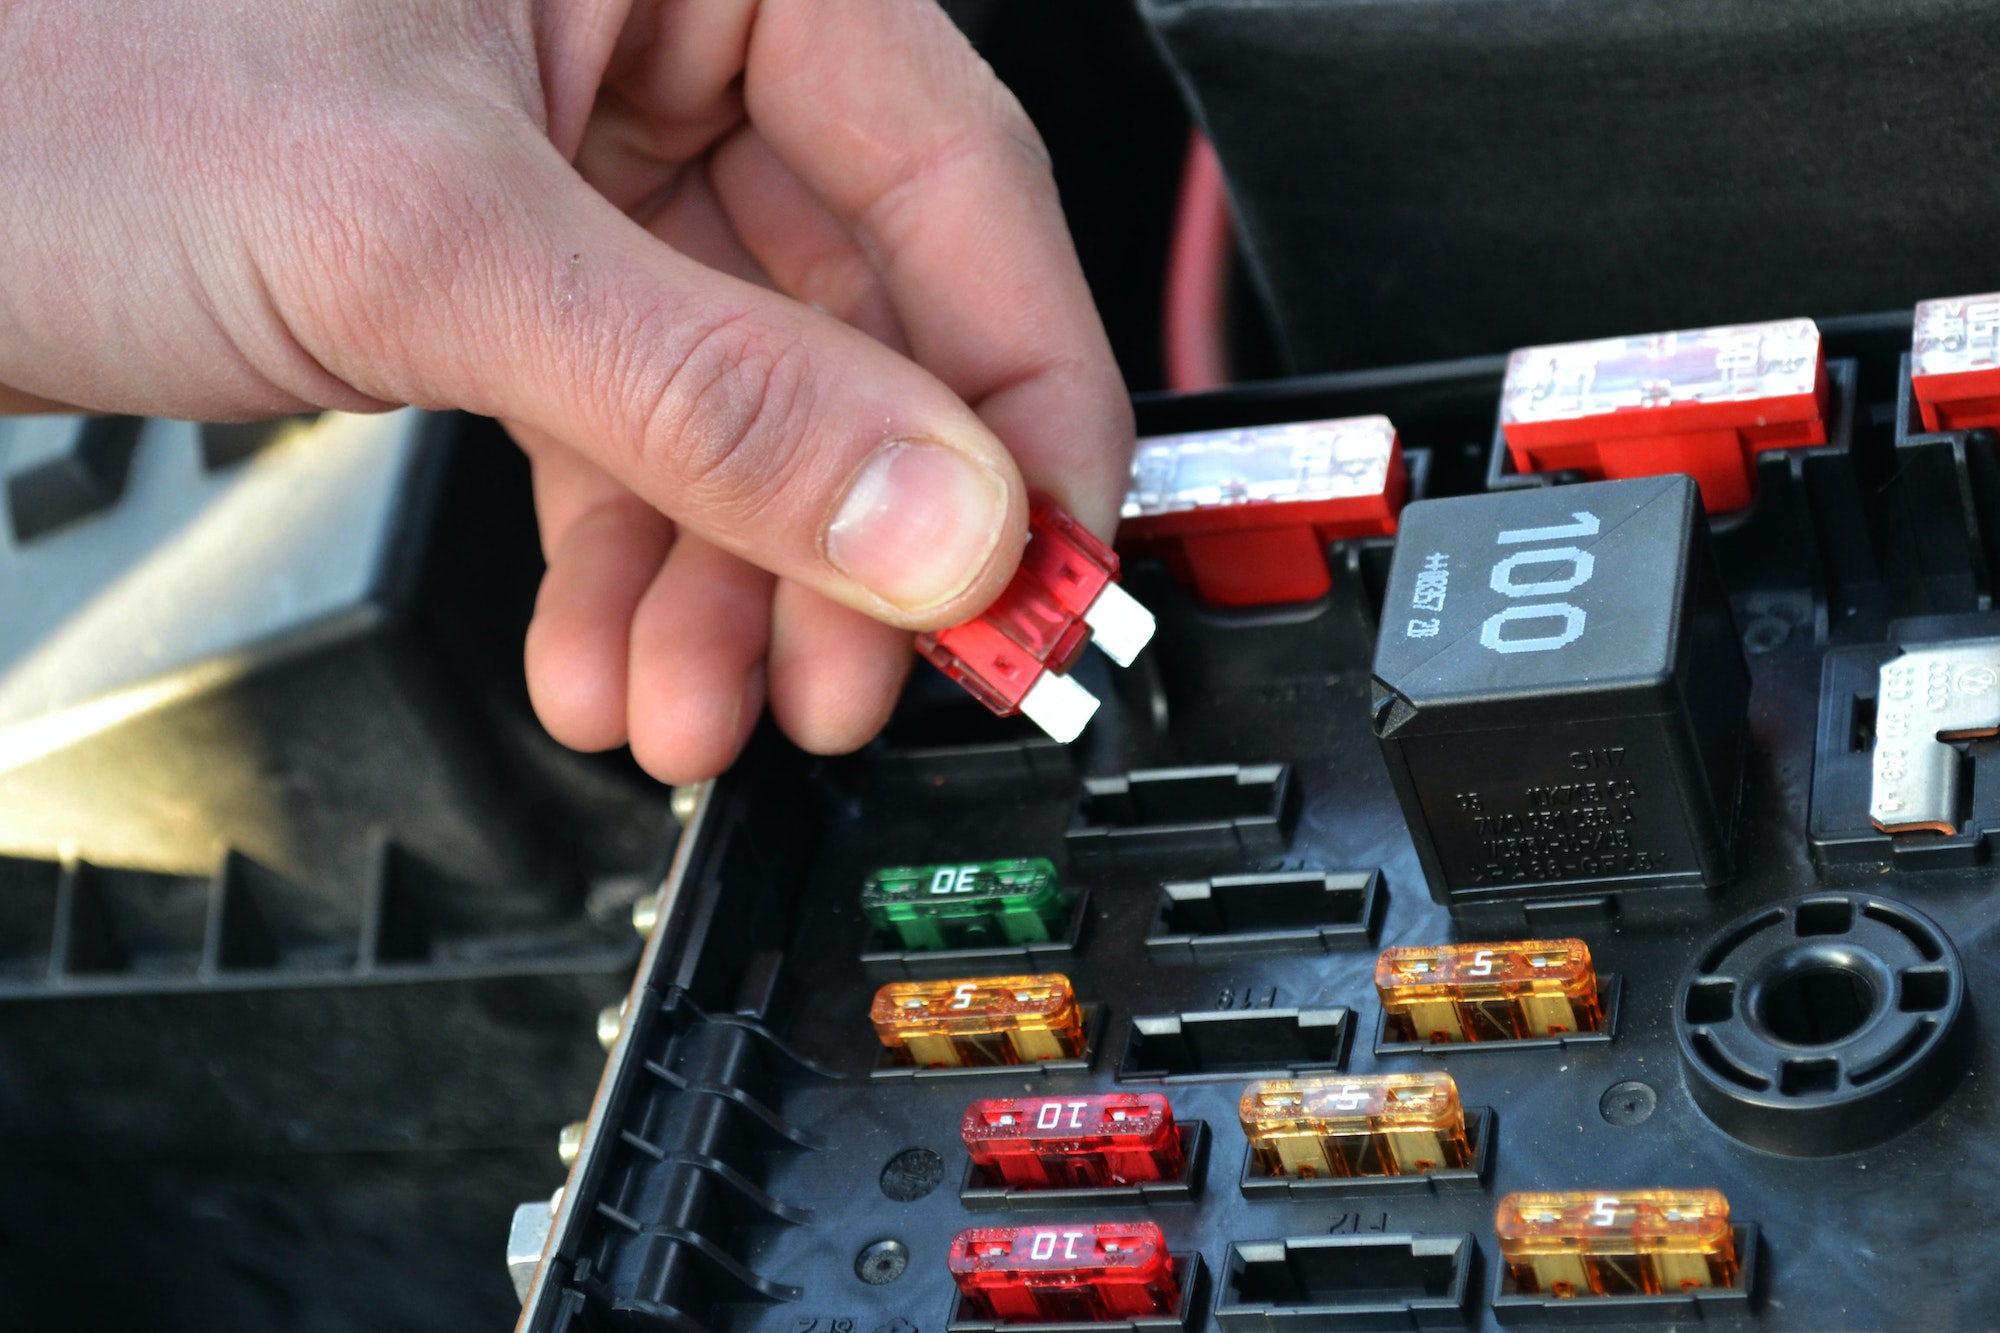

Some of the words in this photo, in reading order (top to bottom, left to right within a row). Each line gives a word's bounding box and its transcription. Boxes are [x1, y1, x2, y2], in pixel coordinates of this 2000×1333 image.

[1480, 511, 1600, 654] 100
[930, 866, 980, 895] 30
[1468, 950, 1494, 976] 5
[953, 984, 977, 1009] 5
[1336, 1085, 1361, 1111] 5
[1037, 1102, 1088, 1129] 10
[1594, 1198, 1621, 1227] 5
[1031, 1232, 1084, 1260] 10
